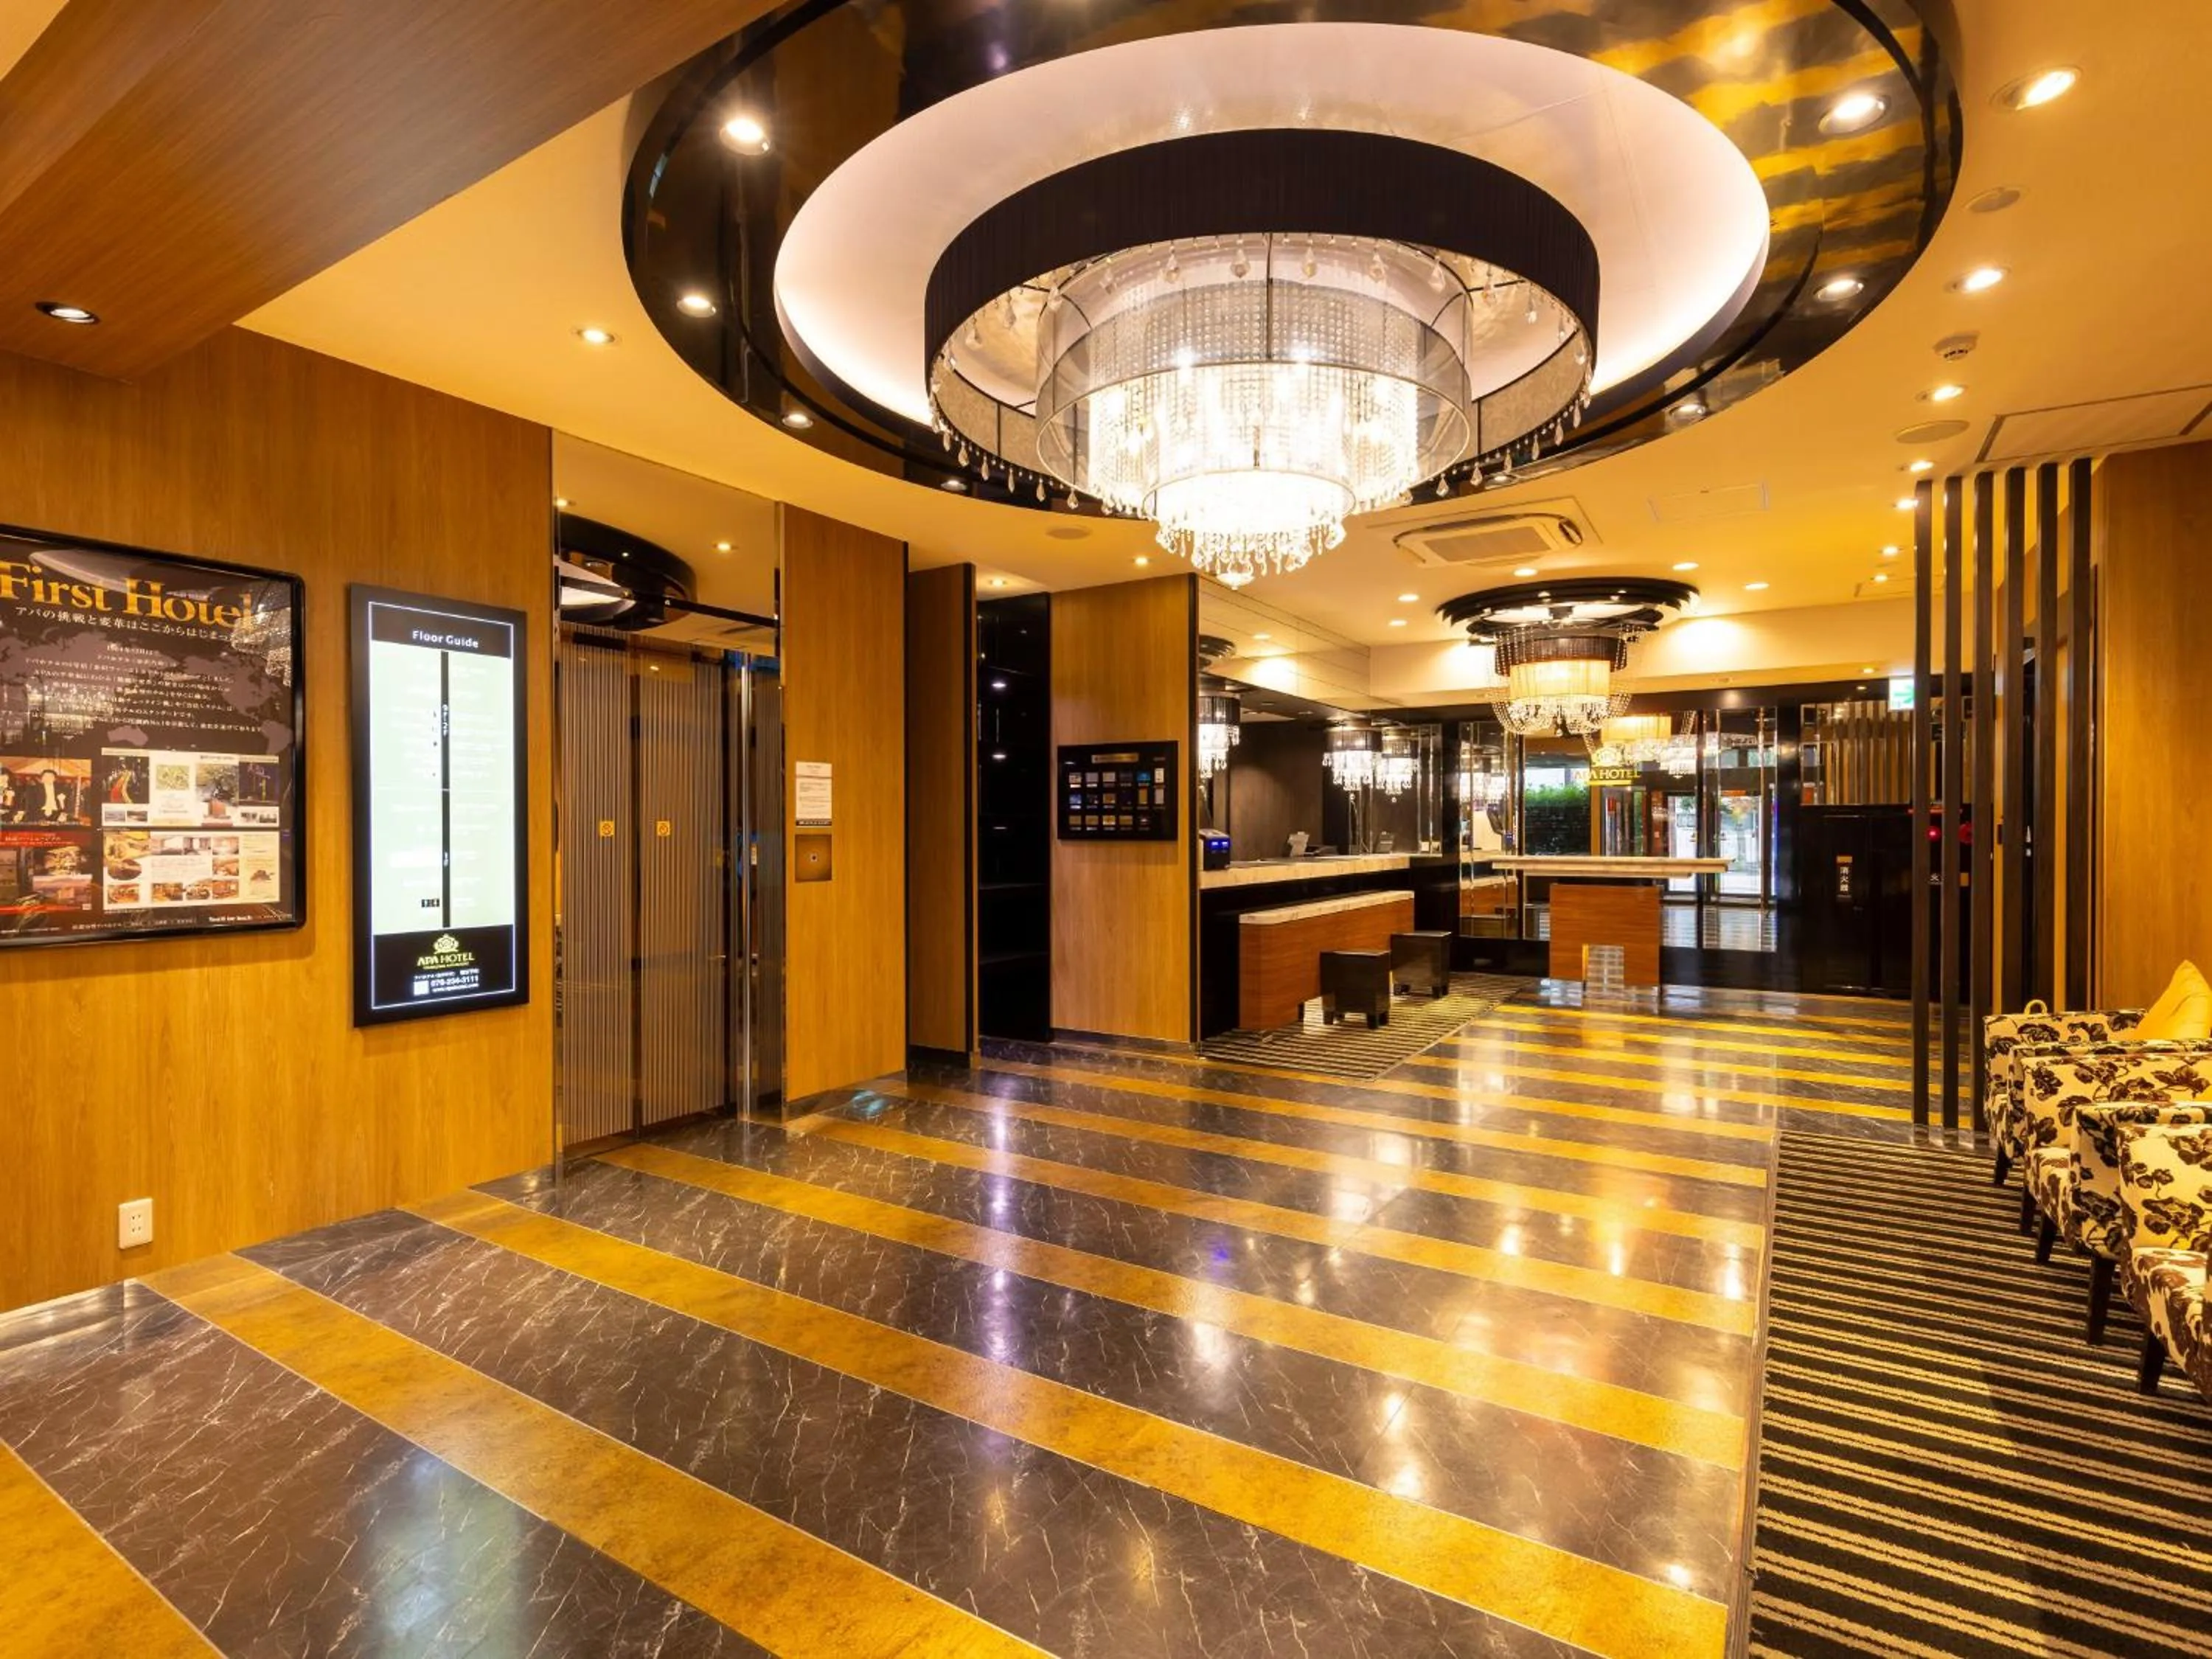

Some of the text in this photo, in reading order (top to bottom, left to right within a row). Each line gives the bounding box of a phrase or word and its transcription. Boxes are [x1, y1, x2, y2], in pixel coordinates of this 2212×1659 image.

[0, 560, 253, 636] First Hotel
[412, 630, 479, 648] Floor Guide
[1599, 768, 1641, 779] HOTEL
[417, 956, 439, 967] APA
[440, 952, 476, 964] HOTEL
